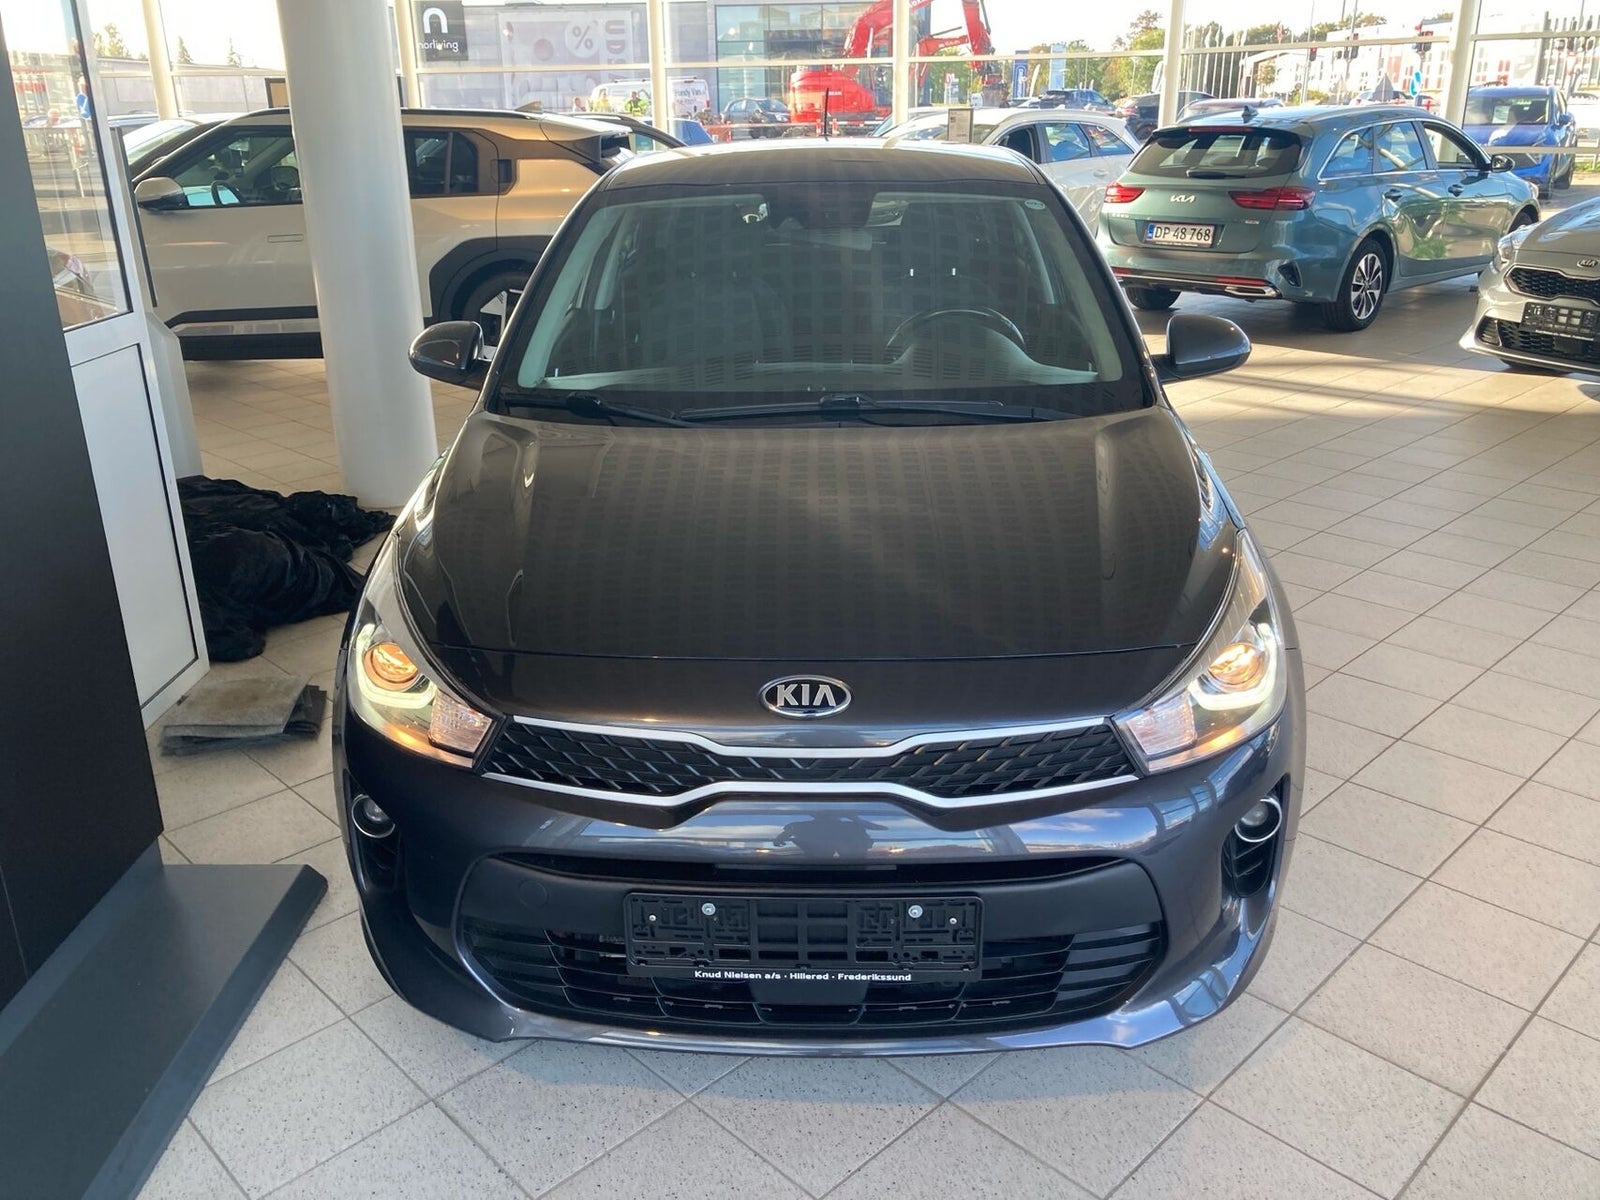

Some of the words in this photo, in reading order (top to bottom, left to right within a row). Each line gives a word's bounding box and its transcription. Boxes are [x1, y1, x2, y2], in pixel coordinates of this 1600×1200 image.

[1154, 226, 1171, 239] DP
[1173, 227, 1187, 241] 48
[1189, 227, 1211, 242] 768
[776, 683, 837, 707] KIA
[694, 970, 722, 979] Knud
[724, 971, 762, 980] Nielsen
[764, 972, 781, 980] a/s
[837, 973, 912, 981] Frederikssund
